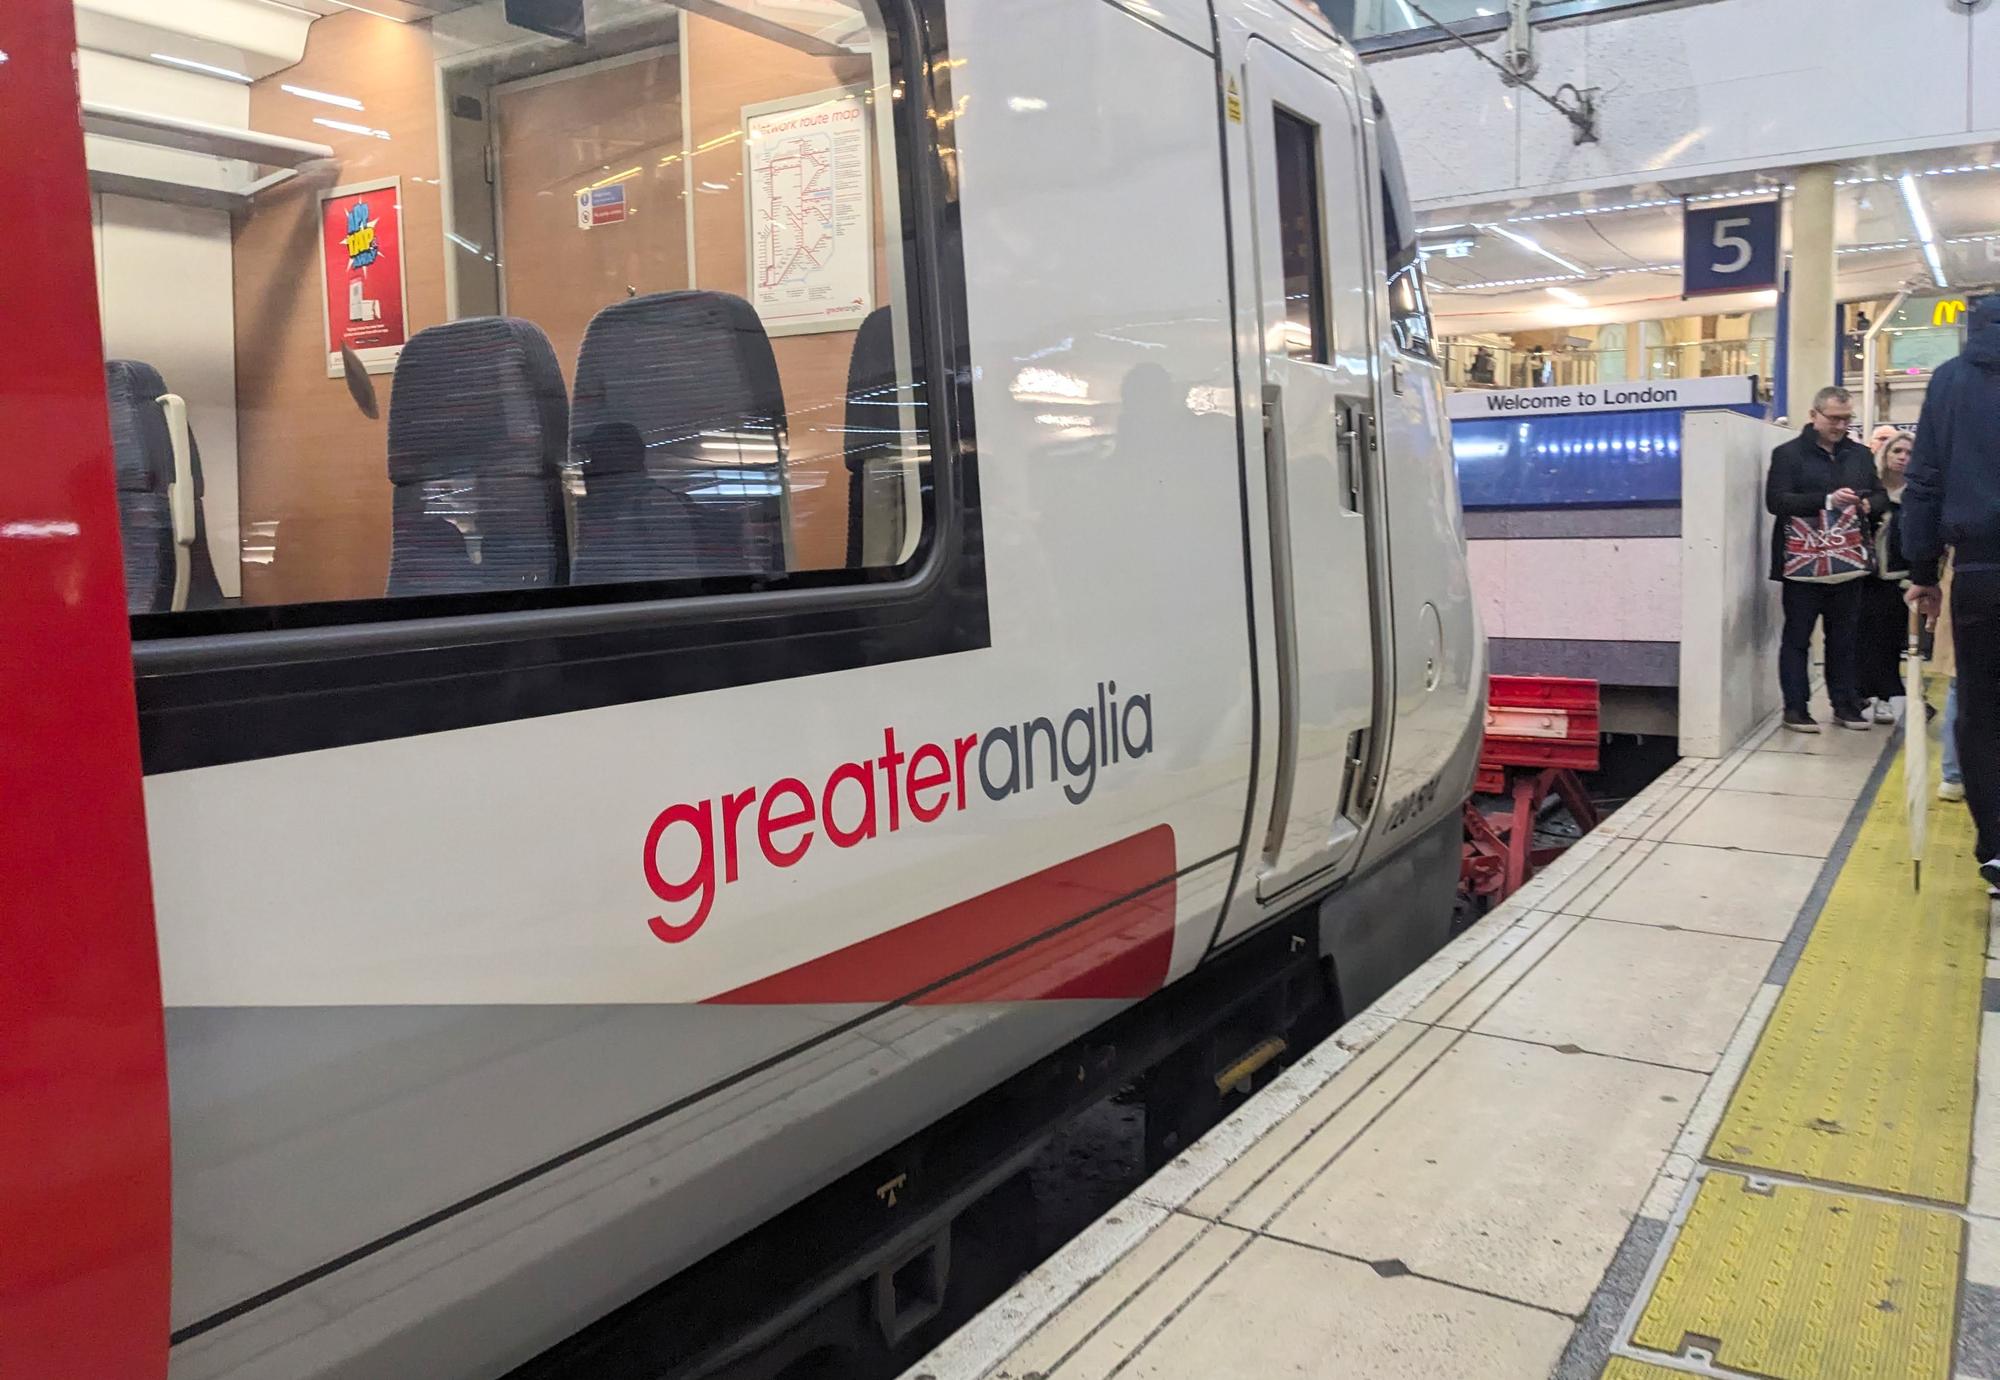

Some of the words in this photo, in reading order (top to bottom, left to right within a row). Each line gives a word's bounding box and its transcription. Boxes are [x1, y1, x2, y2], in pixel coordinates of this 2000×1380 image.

[800, 113, 829, 128] route
[832, 108, 860, 123] map
[346, 226, 375, 258] TAP
[1711, 217, 1752, 273] 5
[1486, 394, 1571, 411] Welcome
[1577, 392, 1597, 406] to
[1603, 387, 1678, 405] London
[643, 680, 1154, 944] greateranglia
